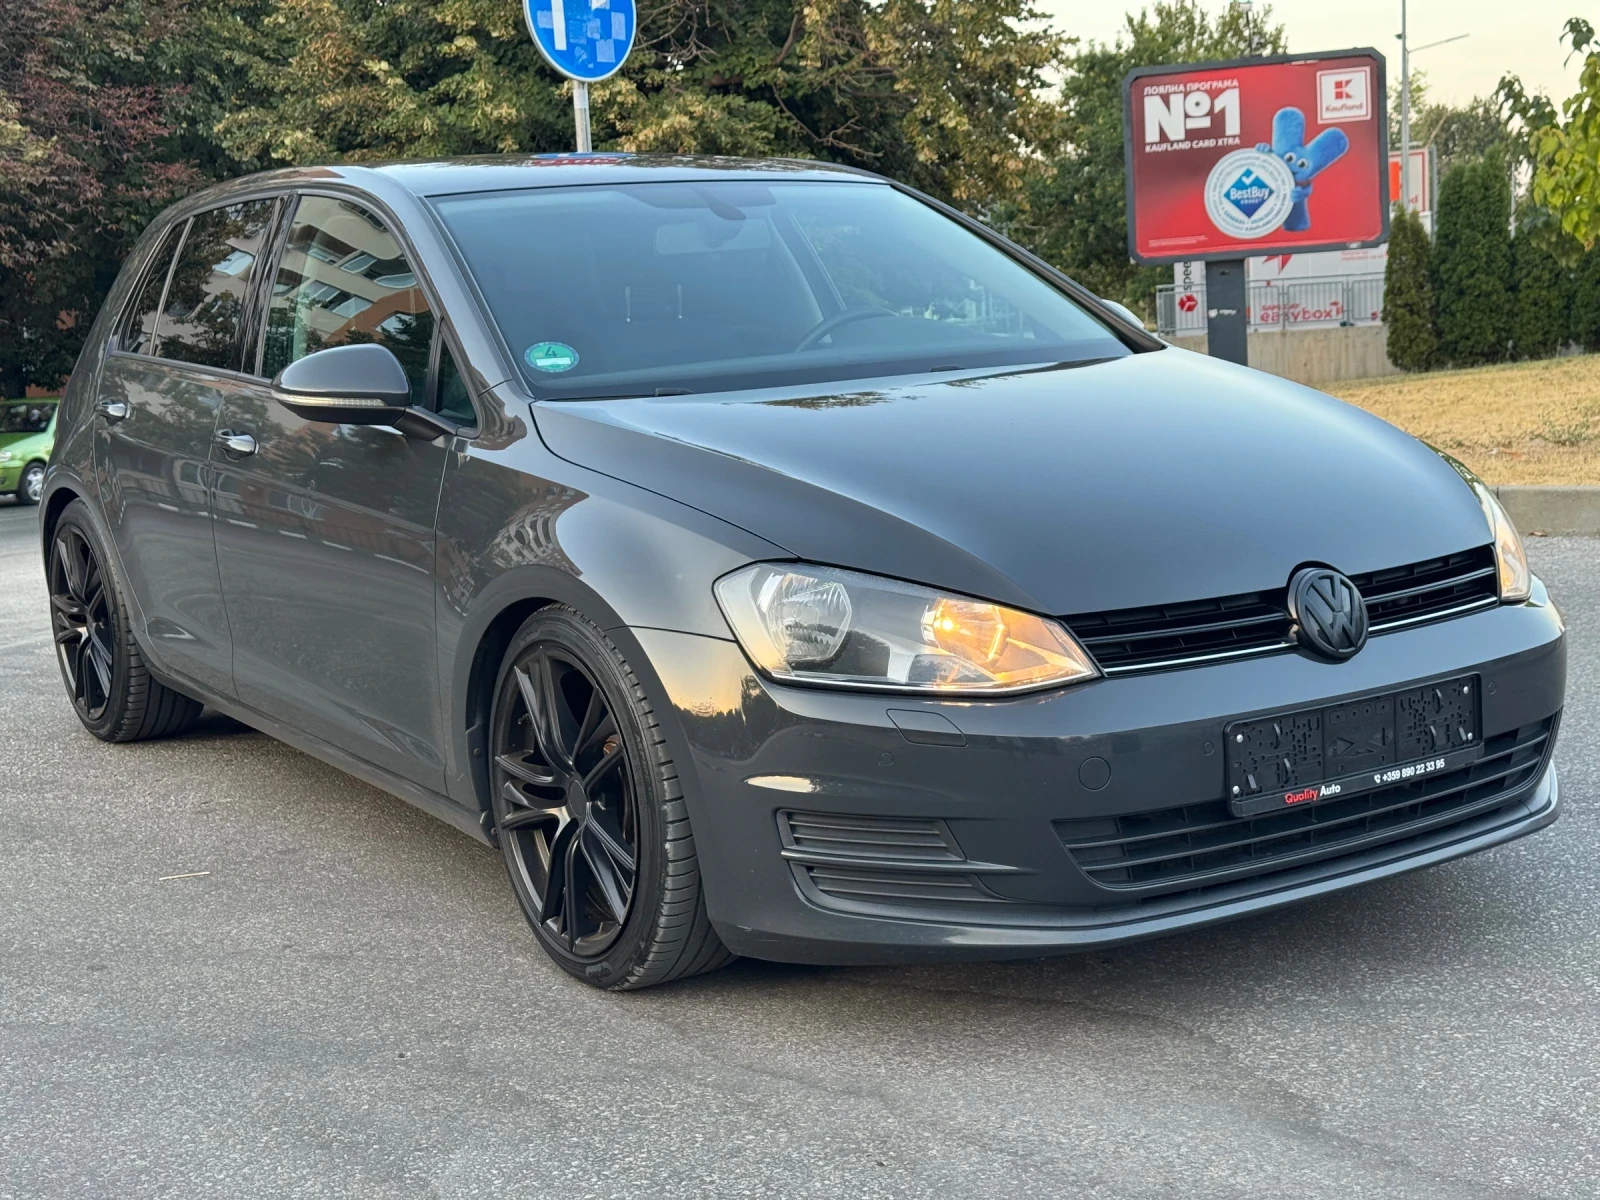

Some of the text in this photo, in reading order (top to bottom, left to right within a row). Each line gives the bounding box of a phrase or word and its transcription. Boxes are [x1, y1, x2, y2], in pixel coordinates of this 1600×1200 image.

[1186, 78, 1240, 92] ПРОГРАМА
[1325, 102, 1364, 112] Kaufland
[1145, 136, 1240, 153] KAUFLAND CARD XTRA
[545, 346, 558, 358] 4
[1382, 758, 1445, 782] +359 890 22 33 95
[1284, 784, 1341, 804] Quality Auto
